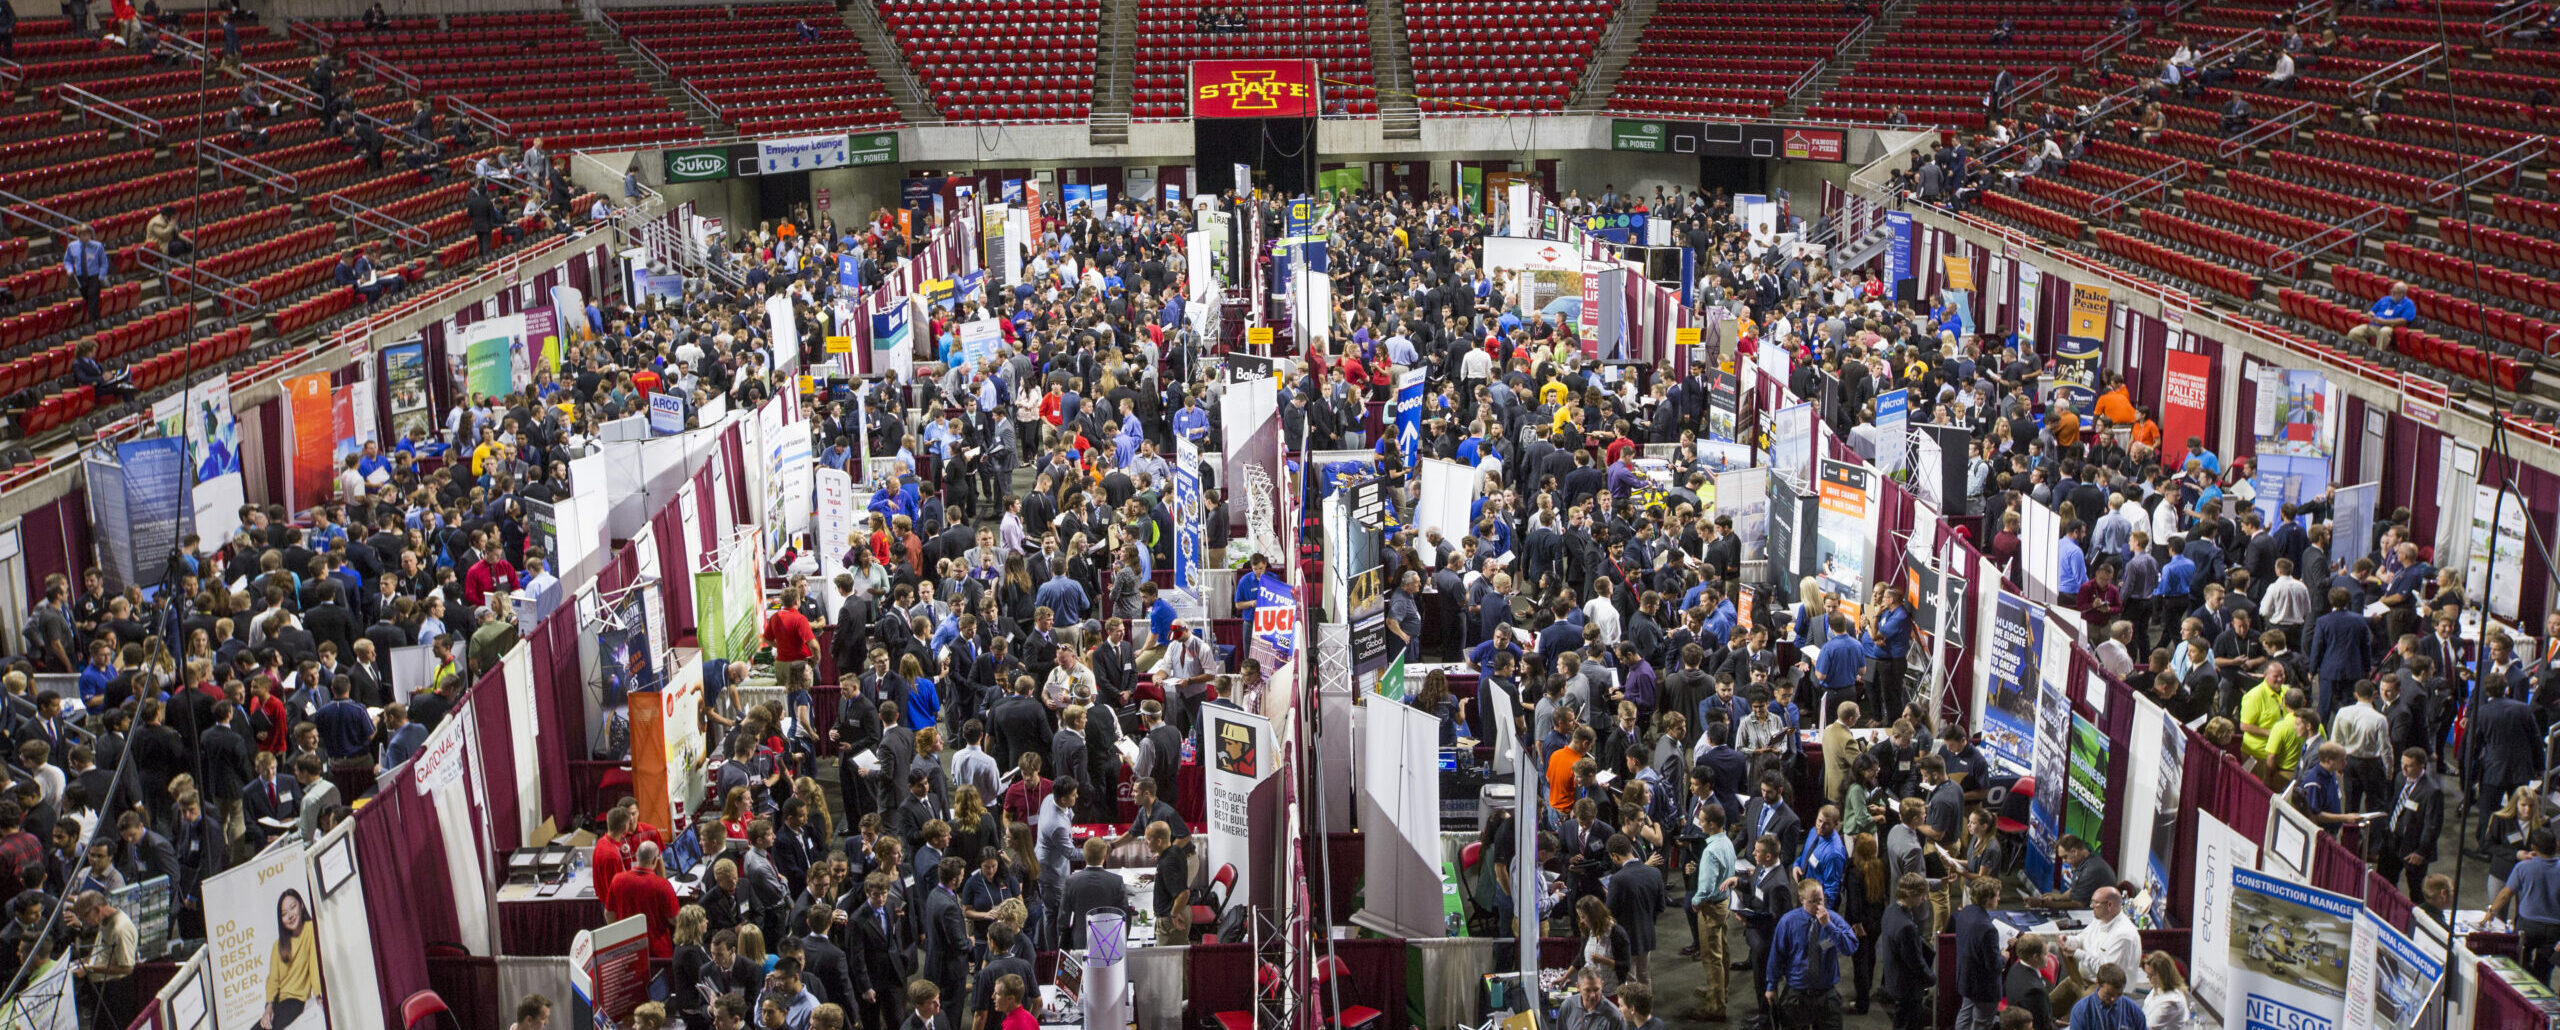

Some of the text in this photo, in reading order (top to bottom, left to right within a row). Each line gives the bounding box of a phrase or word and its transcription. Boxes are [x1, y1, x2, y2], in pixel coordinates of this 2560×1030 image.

[1199, 81, 1310, 99] STATE
[765, 139, 843, 155] Employer Lounge
[1629, 140, 1656, 149] PIONEER
[1811, 138, 1838, 146] FAMOUS
[1818, 145, 1838, 153] PIZZA
[676, 155, 721, 174] Sukup
[863, 153, 890, 164] PIONEER
[1585, 278, 1599, 289] RE
[2073, 298, 2106, 311] Peace
[2074, 288, 2107, 303] Make
[2168, 383, 2206, 401] PALLETS
[653, 397, 679, 412] ARCO
[1878, 396, 1905, 414] Micron
[2167, 395, 2205, 410] EFFICIENTLY
[1260, 587, 1294, 606] Try your
[1926, 591, 1939, 607] HO
[1995, 617, 2028, 639] HUSCO:
[1366, 637, 1384, 649] Global
[1993, 637, 2009, 650] GOOD
[1994, 628, 2027, 648] WE ELEVATE
[1990, 657, 2017, 674] TO GREAT
[1992, 647, 2021, 666] MACHINES
[1990, 666, 2021, 686] MACHINES.
[2070, 751, 2107, 789] ENGINEER
[1214, 787, 1226, 799] OUR
[2068, 775, 2105, 812] EFFICIENCY
[1214, 798, 1220, 808] IS
[1222, 800, 1229, 811] TO
[1231, 804, 1240, 814] BE
[1214, 809, 1228, 822] BEST
[1214, 820, 1248, 837] IN AMERIC
[257, 861, 285, 886] you
[2202, 844, 2216, 943] ebeam
[2235, 873, 2354, 917] CONSTRUCTION MANAGE
[216, 919, 236, 938] DO
[217, 926, 256, 952] YOUR
[219, 943, 254, 969] BEST
[2397, 942, 2437, 979] CONTRACTOR
[221, 954, 264, 983] WORK
[224, 973, 263, 1000] EVER.
[2246, 1000, 2333, 1030] NELSON
